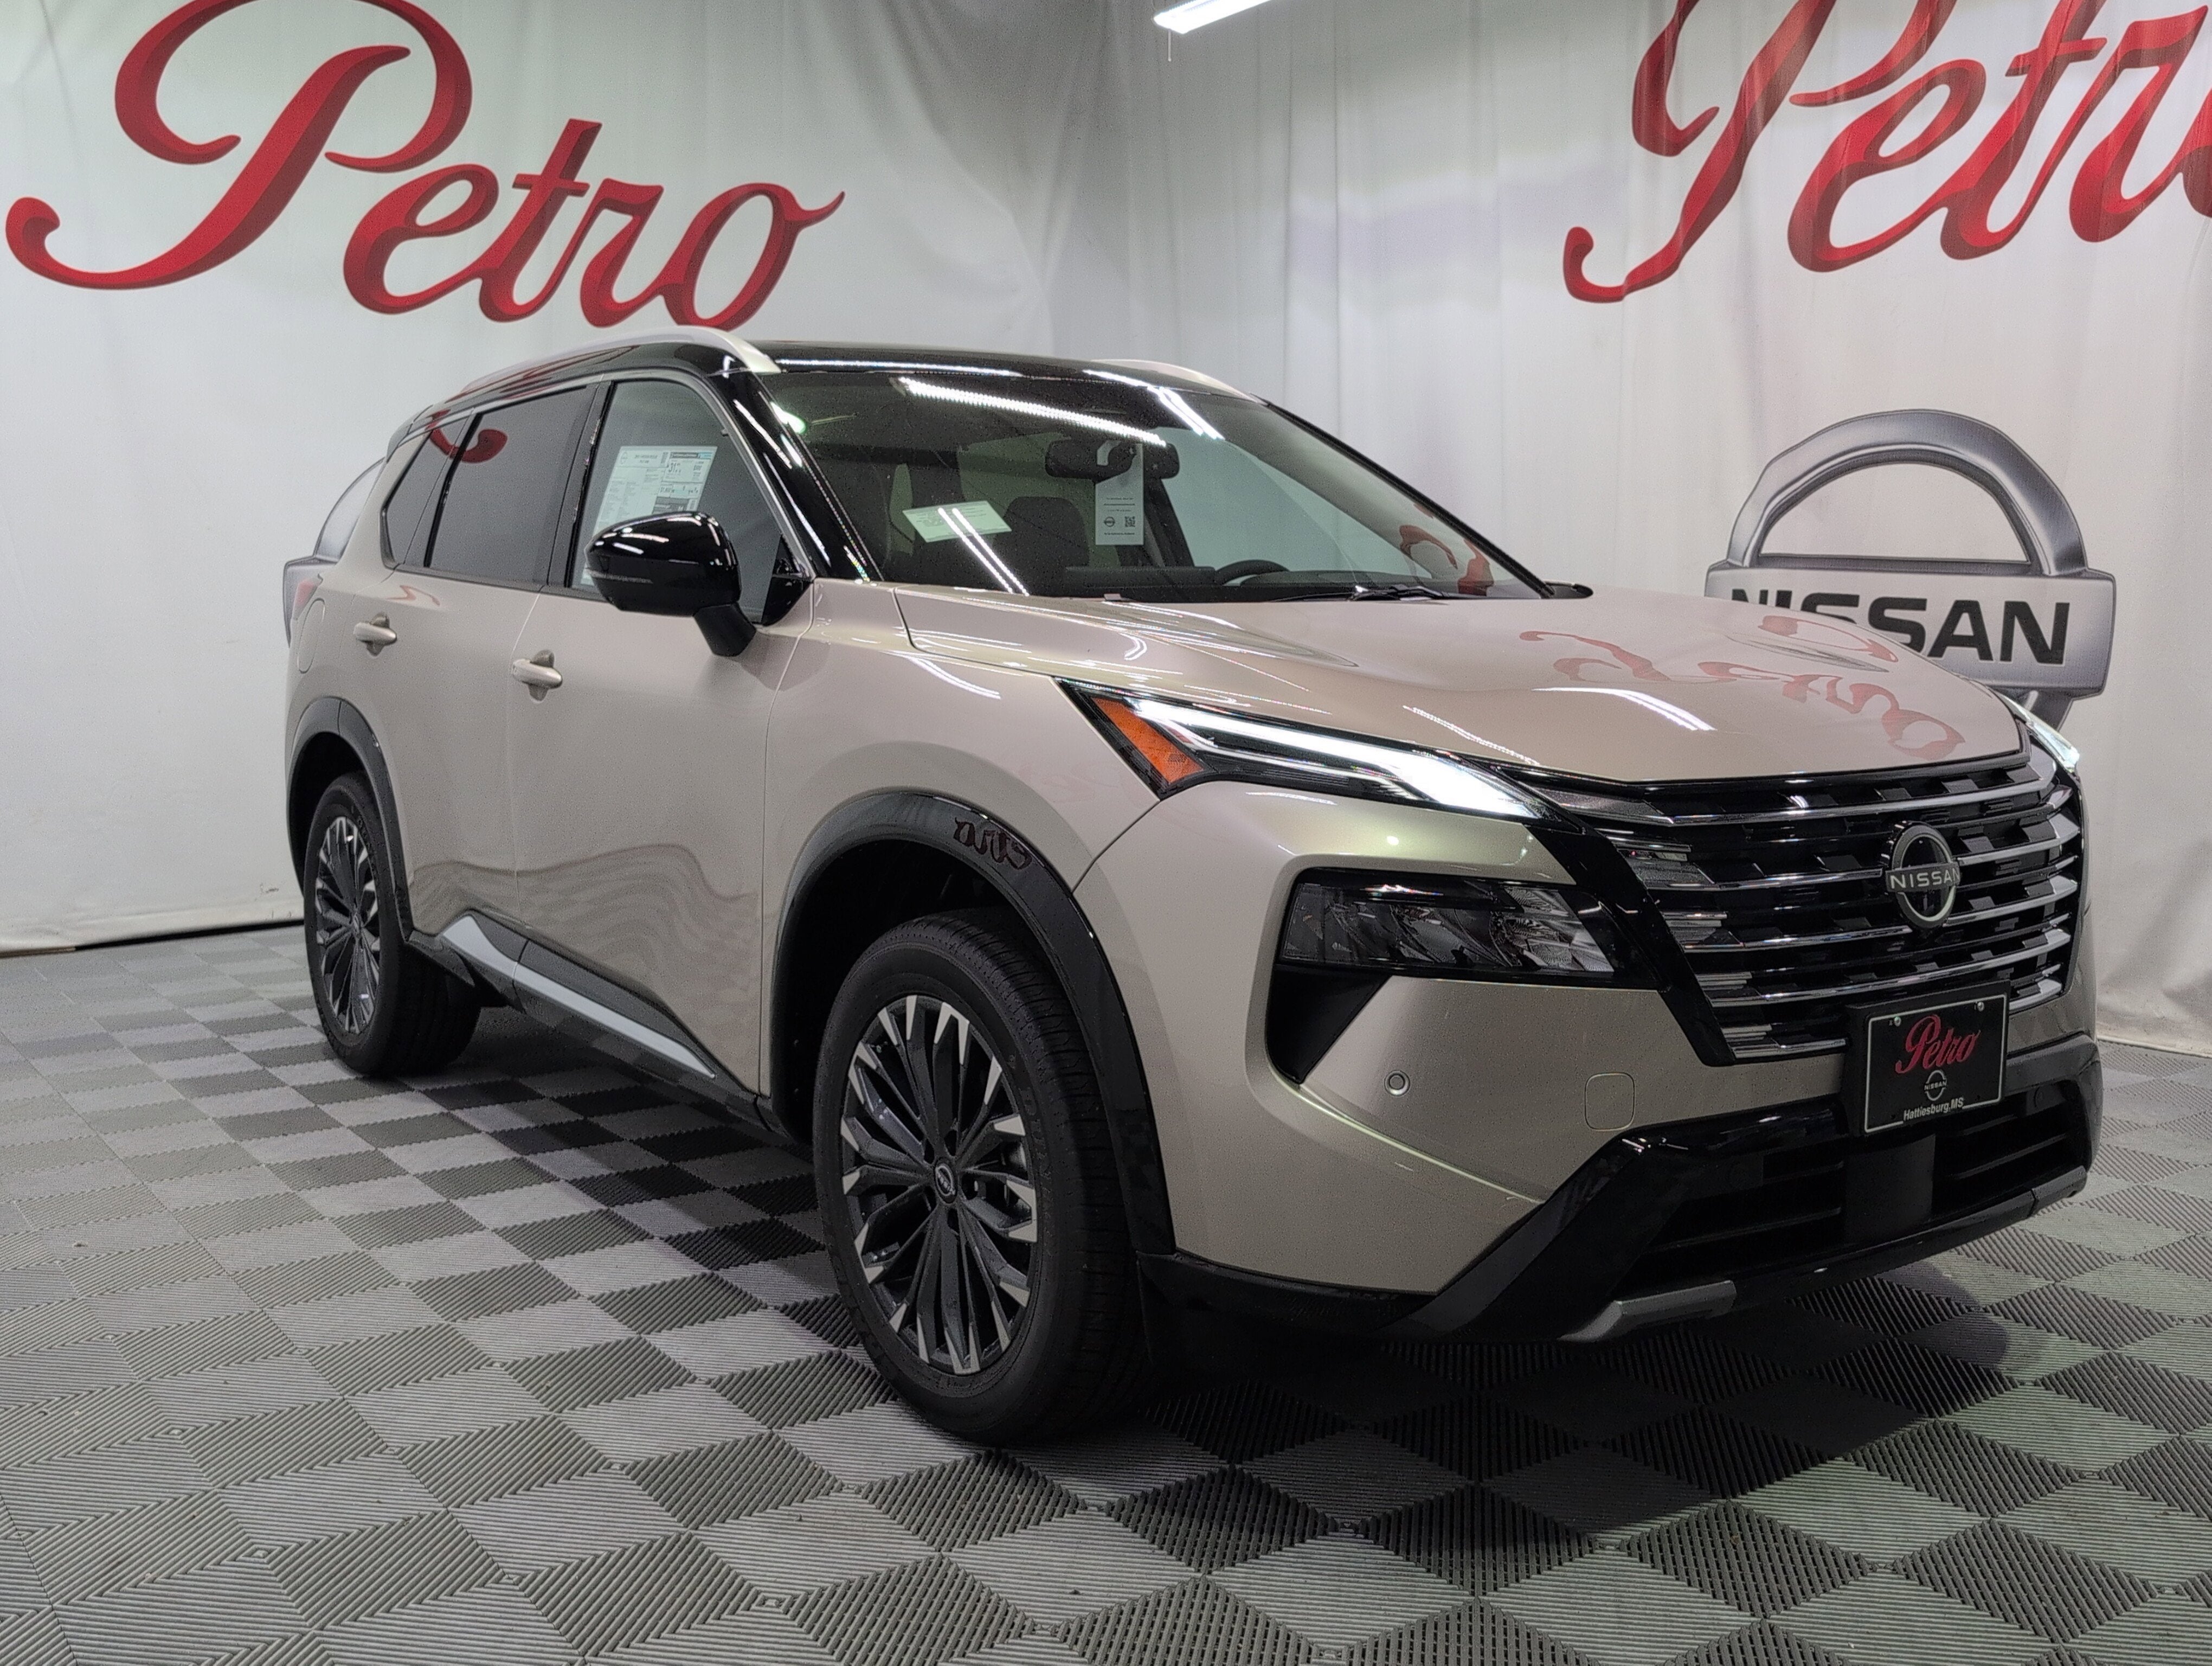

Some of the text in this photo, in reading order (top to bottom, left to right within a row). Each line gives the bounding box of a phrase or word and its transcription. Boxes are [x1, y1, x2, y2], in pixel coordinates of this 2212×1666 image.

[5, 0, 845, 331] Petro
[1562, 0, 2212, 303] Petr
[1732, 589, 2070, 665] SAN
[1889, 868, 1960, 889] NISSAN
[1895, 1014, 1981, 1074] Petro
[1924, 1080, 1947, 1091] NISSAN
